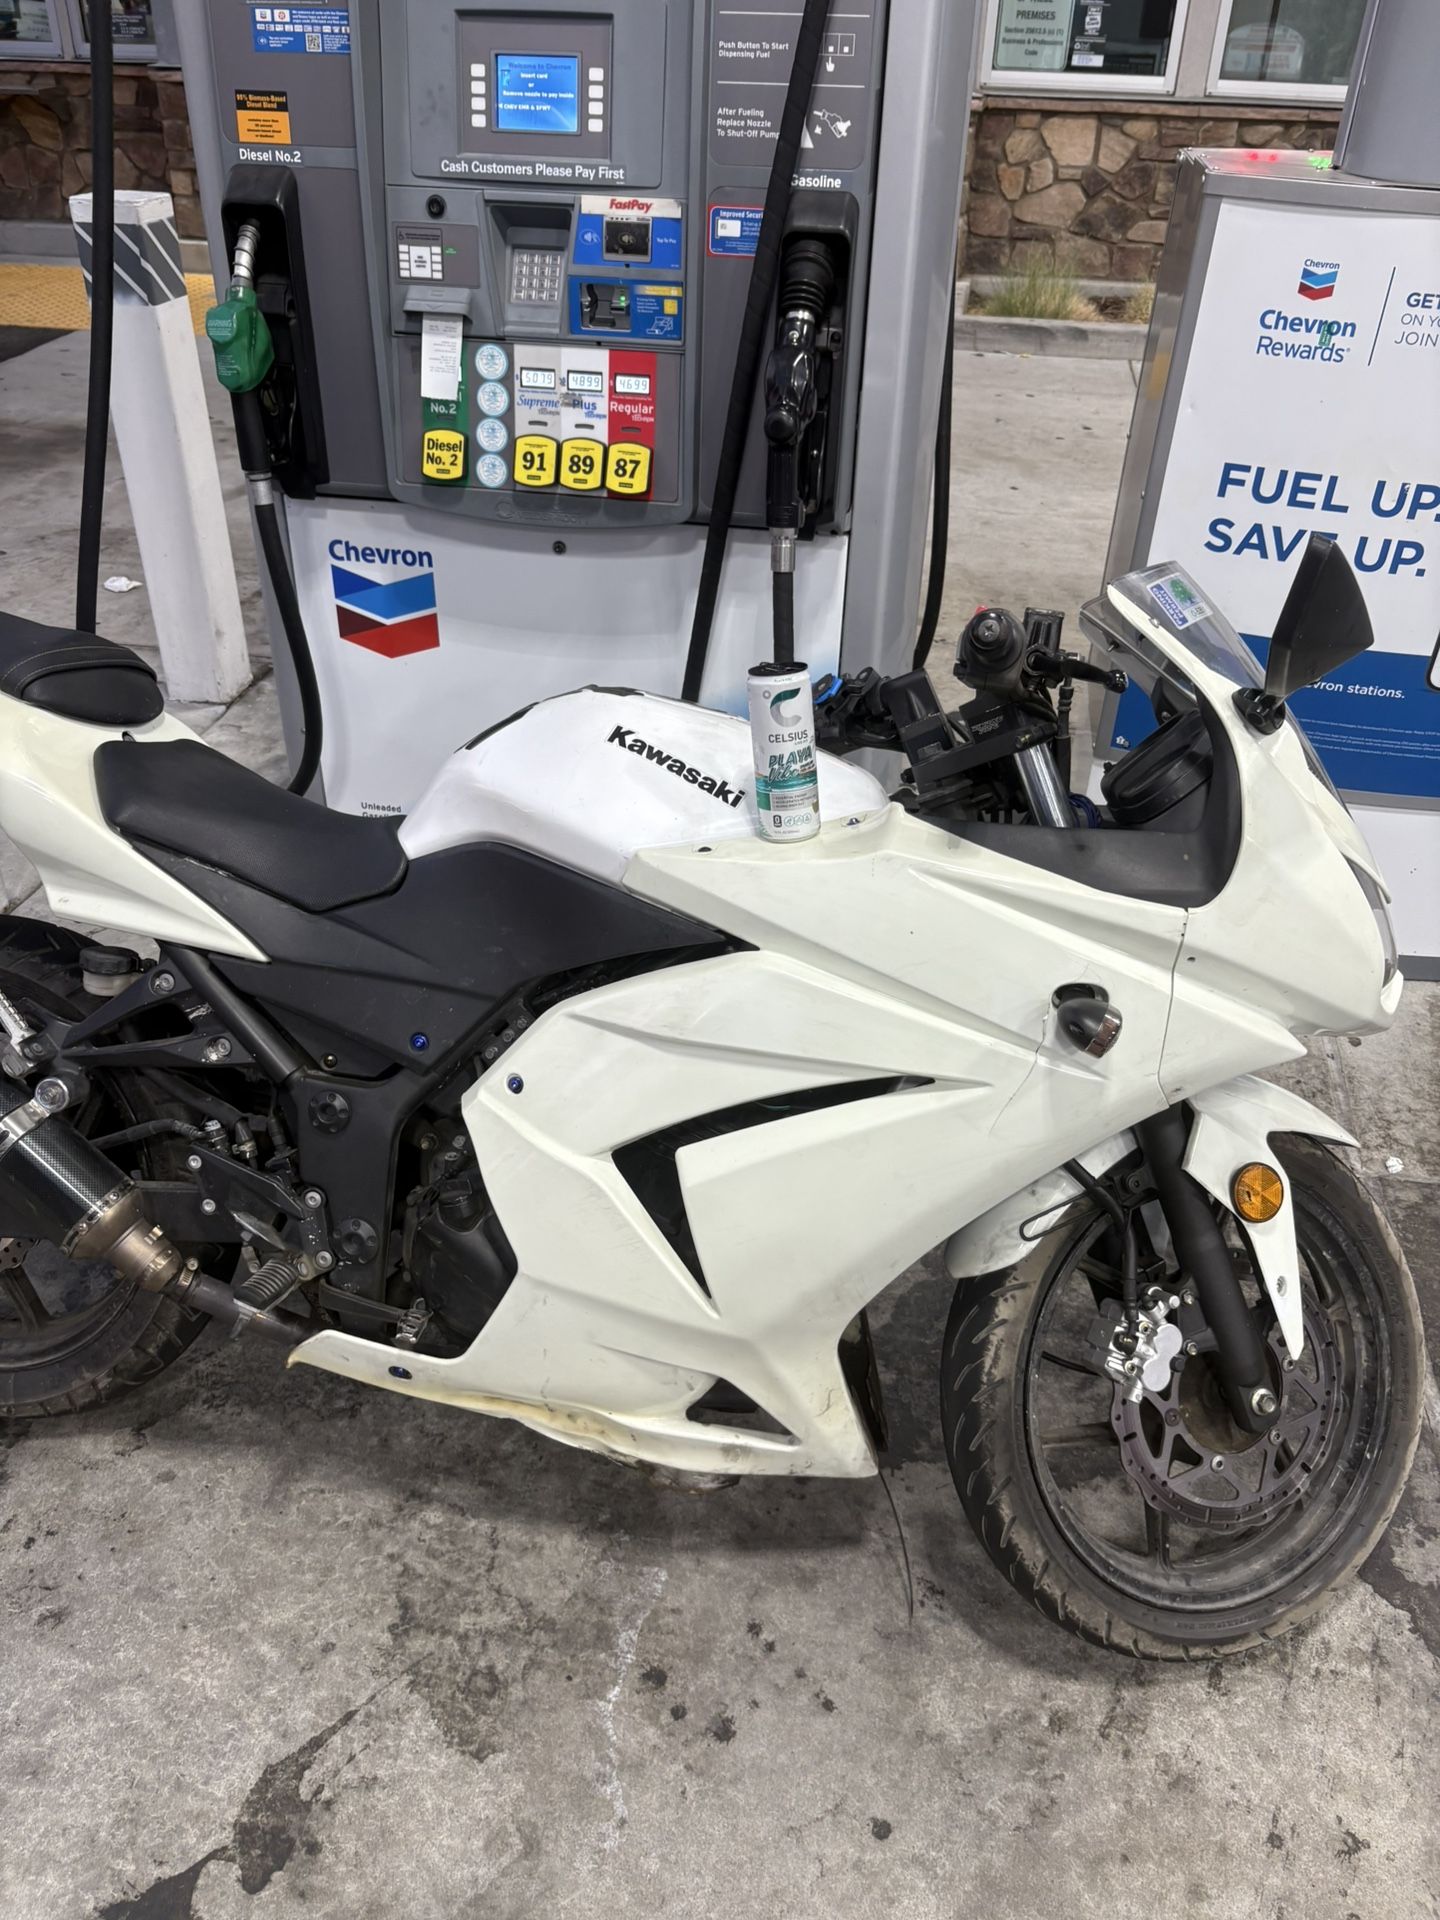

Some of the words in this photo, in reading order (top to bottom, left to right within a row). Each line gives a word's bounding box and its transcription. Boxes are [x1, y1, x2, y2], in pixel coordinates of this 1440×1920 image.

[1016, 10, 1056, 20] PREMISES
[719, 41, 736, 49] Push
[762, 42, 770, 50] To
[771, 42, 789, 50] Start
[718, 50, 755, 59] Dispensing
[509, 62, 536, 70] Welcome
[536, 72, 549, 80] card
[502, 90, 523, 98] Remove
[717, 107, 736, 116] After
[738, 108, 764, 118] Fueling
[716, 118, 745, 128] Replace
[747, 119, 771, 127] Nozzle
[727, 130, 758, 138] Shut-Off
[239, 148, 272, 161] Diesel
[275, 150, 302, 163] No.2
[441, 159, 469, 173] Cash
[471, 161, 533, 175] Customers
[535, 163, 573, 177] Please
[575, 165, 596, 181] Pay
[598, 166, 625, 180] First
[609, 198, 653, 213] FastPay
[720, 210, 745, 218] Improved
[1304, 259, 1340, 270] Chevron
[1259, 309, 1357, 337] Chevron
[1401, 313, 1425, 326] ON
[1429, 315, 1440, 328] Y
[1394, 331, 1439, 347] JOIN
[517, 394, 560, 409] Supreme
[572, 399, 598, 411] Plus
[610, 400, 654, 416] Regular
[427, 438, 463, 452] Diesel
[426, 452, 445, 466] No.
[449, 454, 458, 466] 2
[522, 451, 546, 471] 91
[568, 454, 595, 474] 89
[614, 458, 641, 479] 87
[1217, 462, 1350, 514] FUEL
[1371, 480, 1440, 522] UP.
[328, 539, 434, 568] Chevron
[1354, 536, 1426, 577] UP.
[1305, 681, 1344, 692] vron
[1346, 683, 1405, 699] stations.
[768, 729, 809, 744] CELSIUS
[768, 745, 812, 768] PLAYA
[607, 725, 746, 808] Kawasaki
[361, 802, 402, 813] Unleaded
